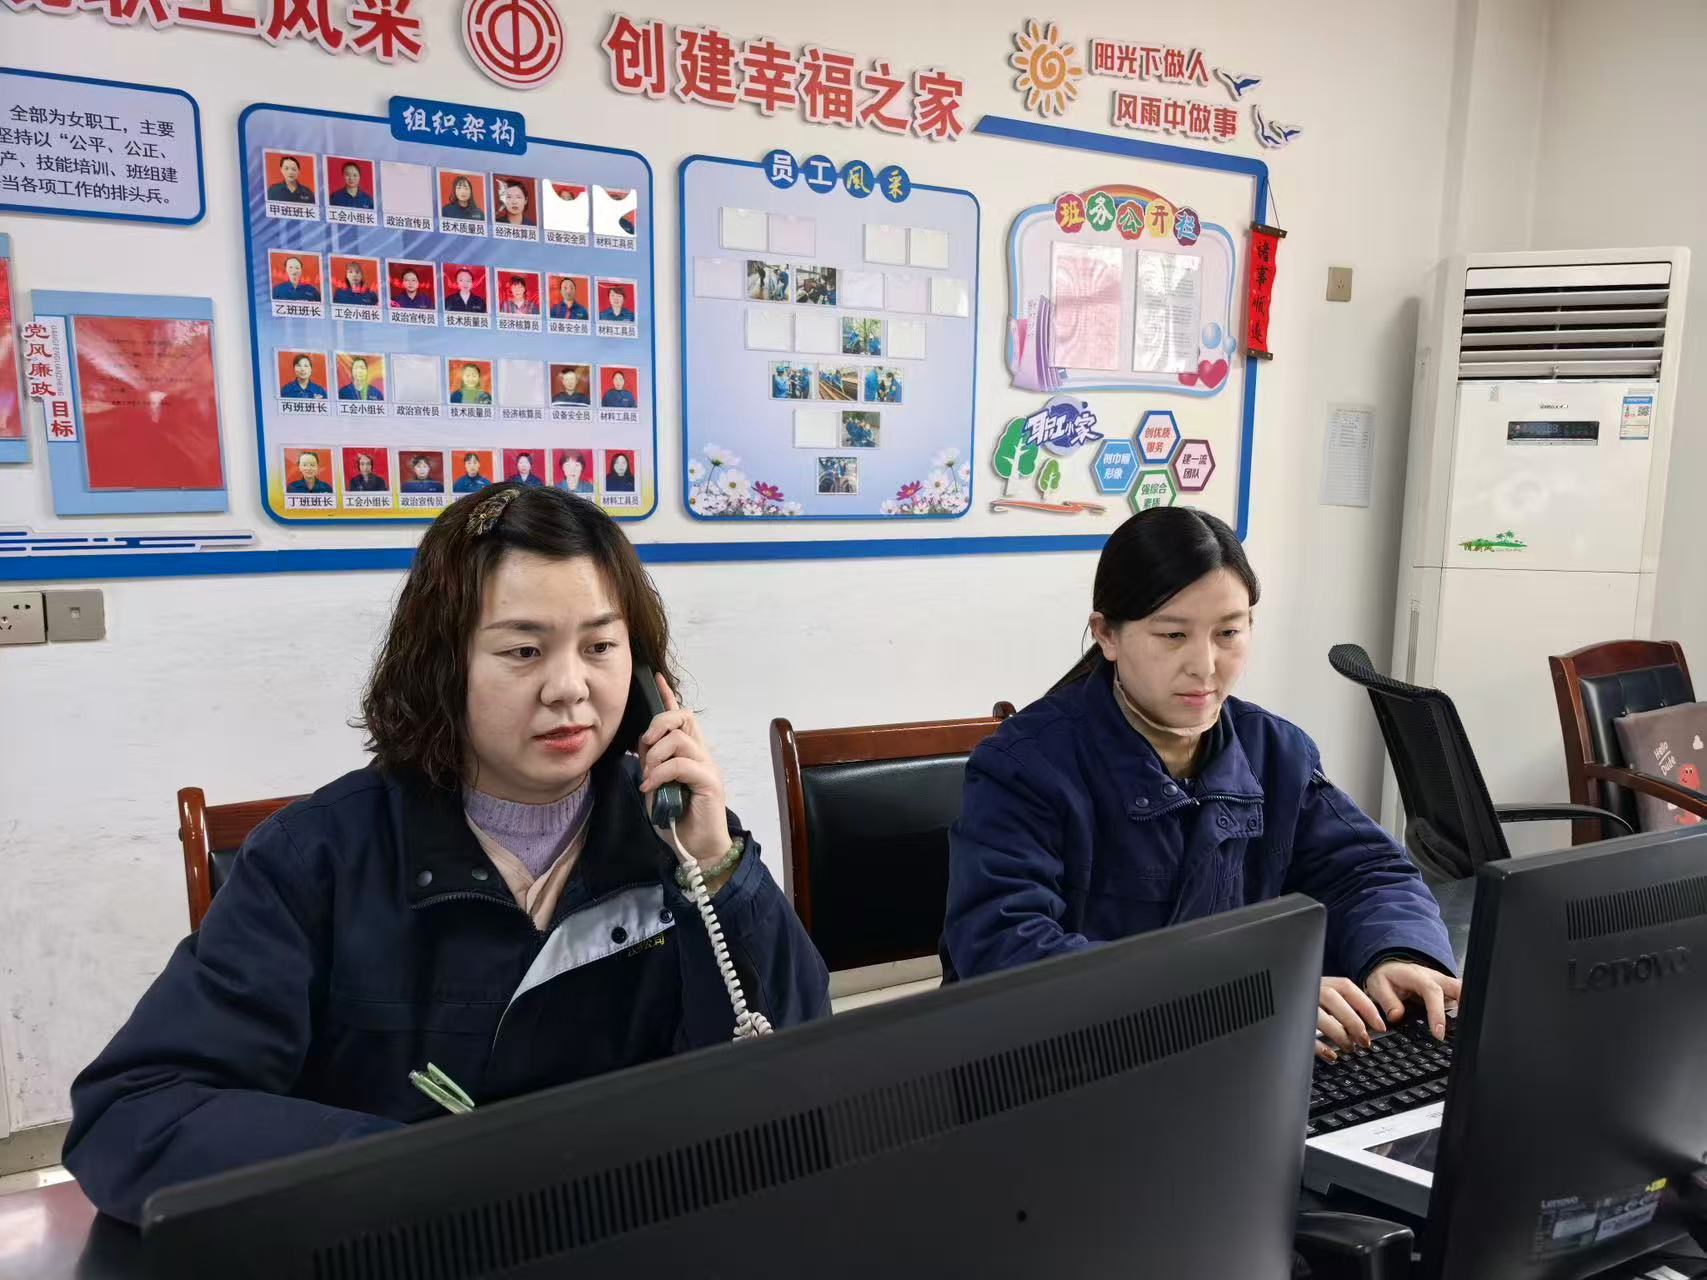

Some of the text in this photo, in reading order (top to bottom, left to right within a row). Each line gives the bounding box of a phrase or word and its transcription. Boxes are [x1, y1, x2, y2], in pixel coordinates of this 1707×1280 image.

[1094, 42, 1209, 82] 阳光下做人
[606, 15, 965, 138] 创建幸福之家
[1117, 93, 1238, 138] 风雨中做事
[402, 105, 515, 148] 组织架构
[269, 204, 316, 219] 甲班班长
[329, 210, 375, 225] 工会小组长
[1059, 196, 1198, 240] 班务公开栏
[386, 215, 432, 230] 政治宣传员
[442, 220, 485, 236] 技术质量员
[495, 226, 537, 241] 经济核算员
[547, 233, 586, 246] 设备安全员
[596, 237, 634, 250] 材料工具员
[275, 304, 321, 317] 乙班班长
[334, 307, 380, 321] 工会小组长
[391, 311, 436, 325] 政治宣传员
[446, 315, 489, 329] 技术质量员
[499, 318, 540, 332] 经济核算员
[550, 322, 589, 334] 设备安全员
[598, 325, 636, 337] 材料工具员
[24, 323, 57, 397] 党风廉政
[282, 401, 328, 414] 丙班班长
[340, 402, 385, 416] 工会小组长
[396, 404, 440, 417] 政治宣传员
[450, 406, 492, 419] 技术质量员
[51, 400, 74, 438] 目标
[502, 408, 543, 421] 经济核算员
[552, 409, 590, 421] 设备安全员
[600, 411, 637, 423] 材料工具员
[1023, 409, 1103, 446] 职工小家
[1144, 427, 1172, 439] 创优质
[1182, 453, 1208, 465] 建一流
[1183, 468, 1200, 479] 团队
[288, 496, 333, 508] 丁班班长
[345, 496, 390, 508] 工会小组长
[400, 496, 444, 508] 政治宣传员
[602, 495, 639, 506] 材料工具员
